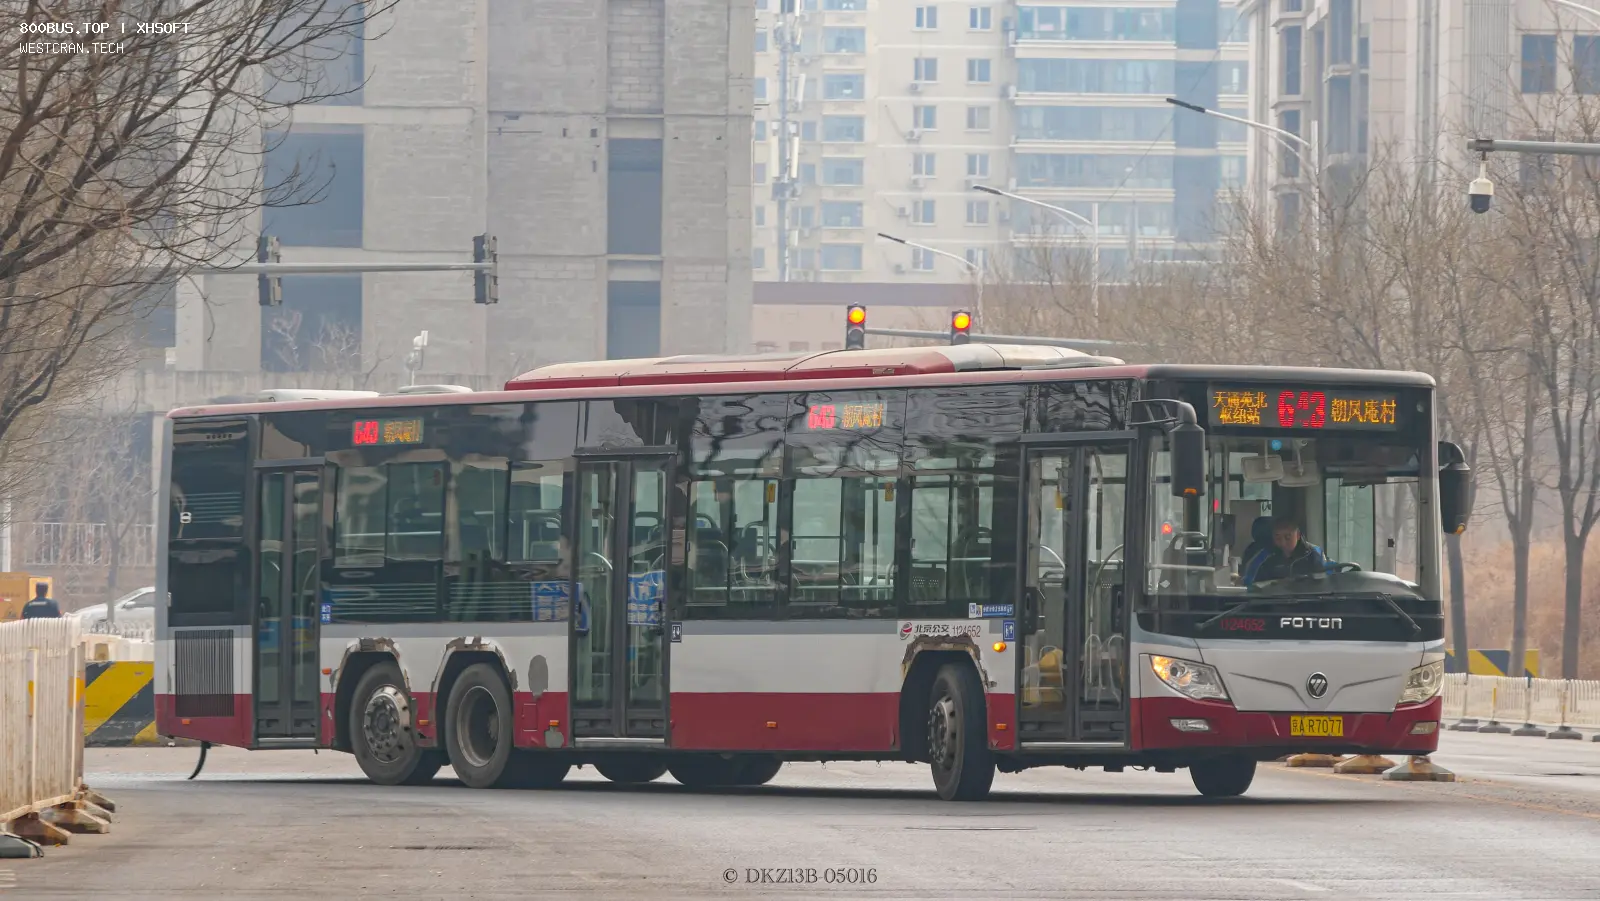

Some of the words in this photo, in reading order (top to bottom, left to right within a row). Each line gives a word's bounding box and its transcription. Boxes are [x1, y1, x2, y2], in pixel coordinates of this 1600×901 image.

[1212, 391, 1268, 408] 天通苑北
[1330, 398, 1397, 425] 朝凤庵村
[914, 624, 950, 634] 北京公交
[1280, 617, 1343, 629] FOTON
[952, 624, 981, 638] 1124652
